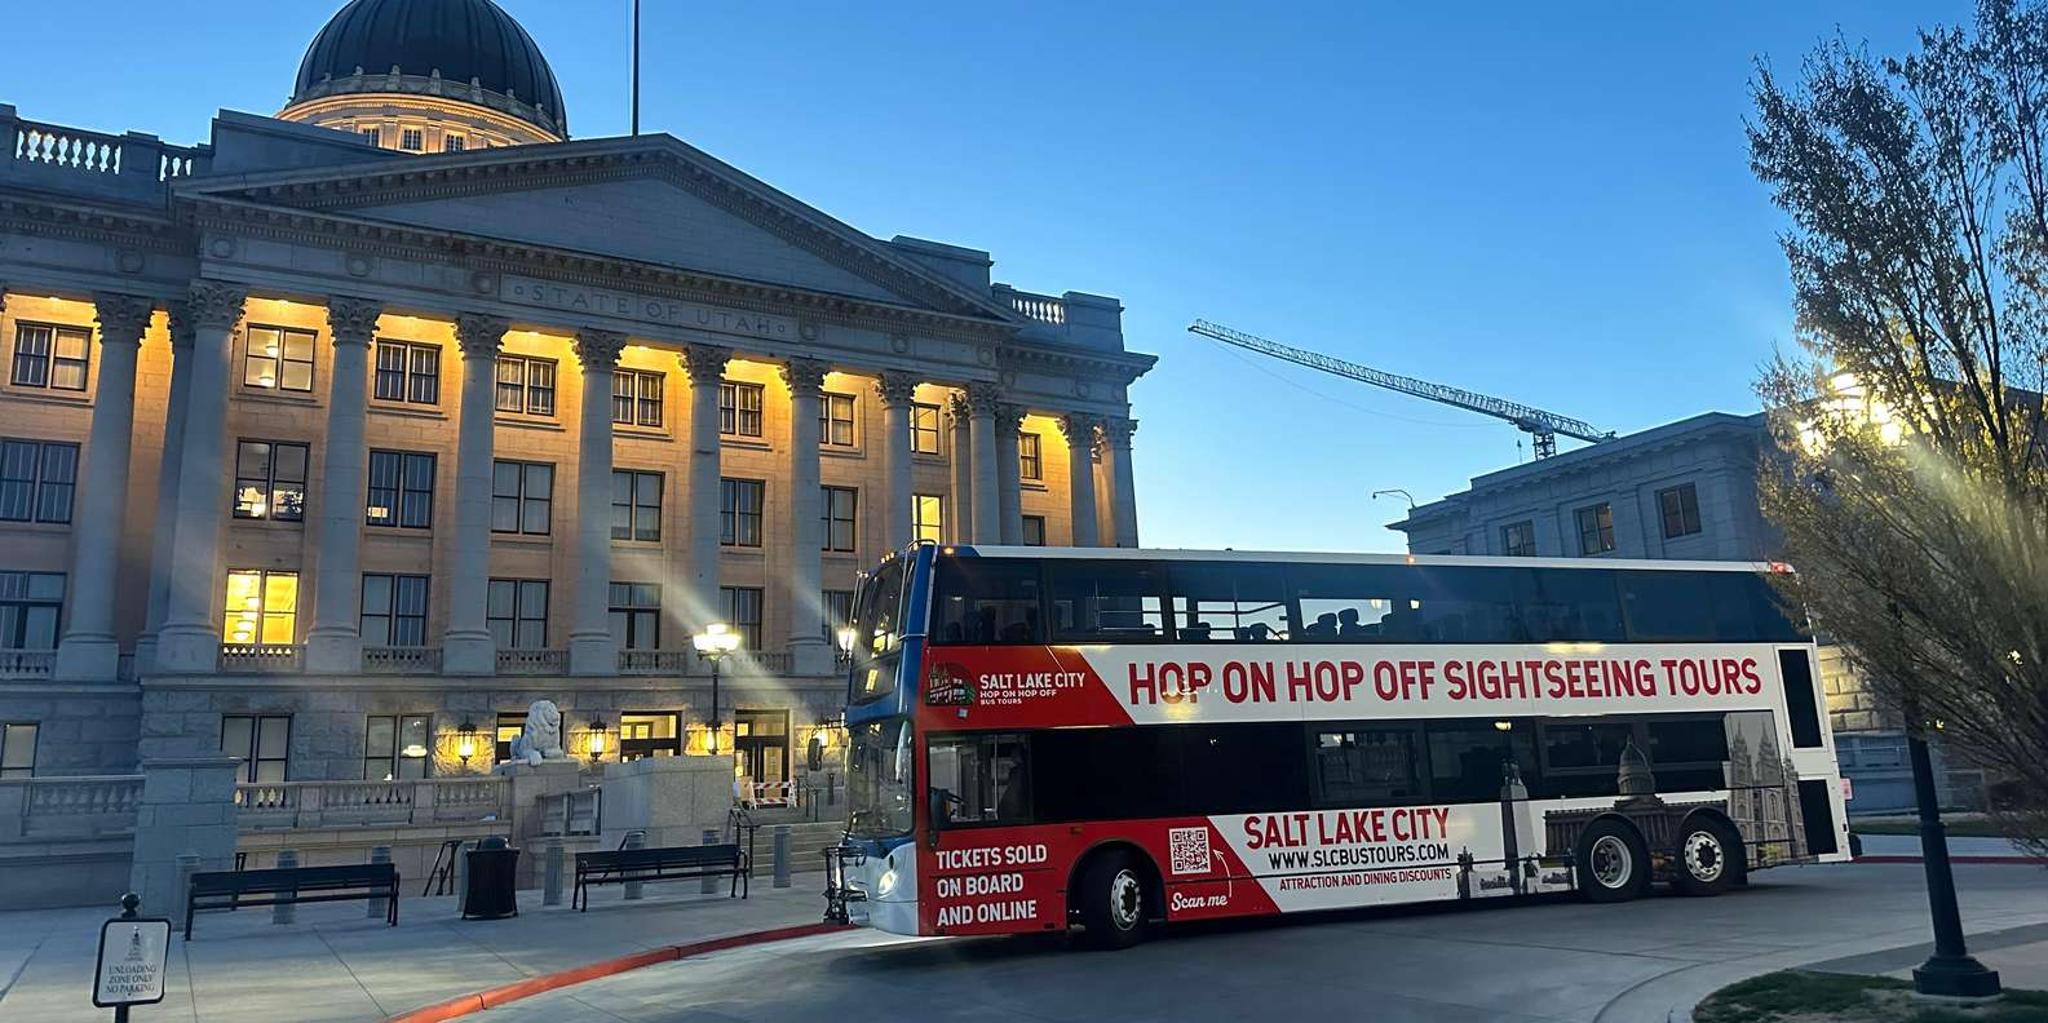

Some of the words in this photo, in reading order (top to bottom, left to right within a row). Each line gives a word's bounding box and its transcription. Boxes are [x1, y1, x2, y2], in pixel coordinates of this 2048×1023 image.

[533, 286, 629, 314] STATE
[645, 302, 681, 321] OF
[697, 311, 770, 334] UTAH
[979, 673, 1013, 689] SALT
[1017, 672, 1052, 689] LAKE
[1055, 672, 1086, 688] CITY
[1128, 661, 1213, 705] HOP
[1222, 660, 1277, 704] ON
[1286, 660, 1365, 702] HOP
[1373, 660, 1436, 701] OFF
[1443, 659, 1657, 700] SIGHTSEEING
[1660, 657, 1762, 696] TOURS
[979, 690, 1000, 698] HOP
[1002, 689, 1018, 698] ON
[1019, 689, 1038, 697] HOP
[1039, 689, 1057, 697] OFF
[1243, 814, 1310, 850] SALT
[1317, 810, 1388, 845] LAKE
[1391, 807, 1450, 842] CITY
[936, 846, 1002, 870] TICKETS
[1004, 844, 1048, 865] SOLD
[1268, 843, 1449, 870] WWW.SLCBUSTOURS.COM
[937, 877, 961, 898] ON
[965, 873, 1024, 894] BOARD
[1279, 876, 1340, 891] ATTRACTION
[1340, 873, 1362, 887] AND
[1364, 870, 1397, 885] DINING
[1399, 867, 1452, 883] DISCOUNTS
[1170, 891, 1206, 911] Scan
[1207, 894, 1229, 908] me
[936, 904, 974, 927] AND
[976, 900, 1038, 923] ONLINE
[109, 964, 157, 974] UNLOADING
[109, 975, 131, 984] ZONE
[132, 974, 152, 983] ONLY
[106, 985, 119, 993] NO
[120, 984, 155, 993] PARKING
